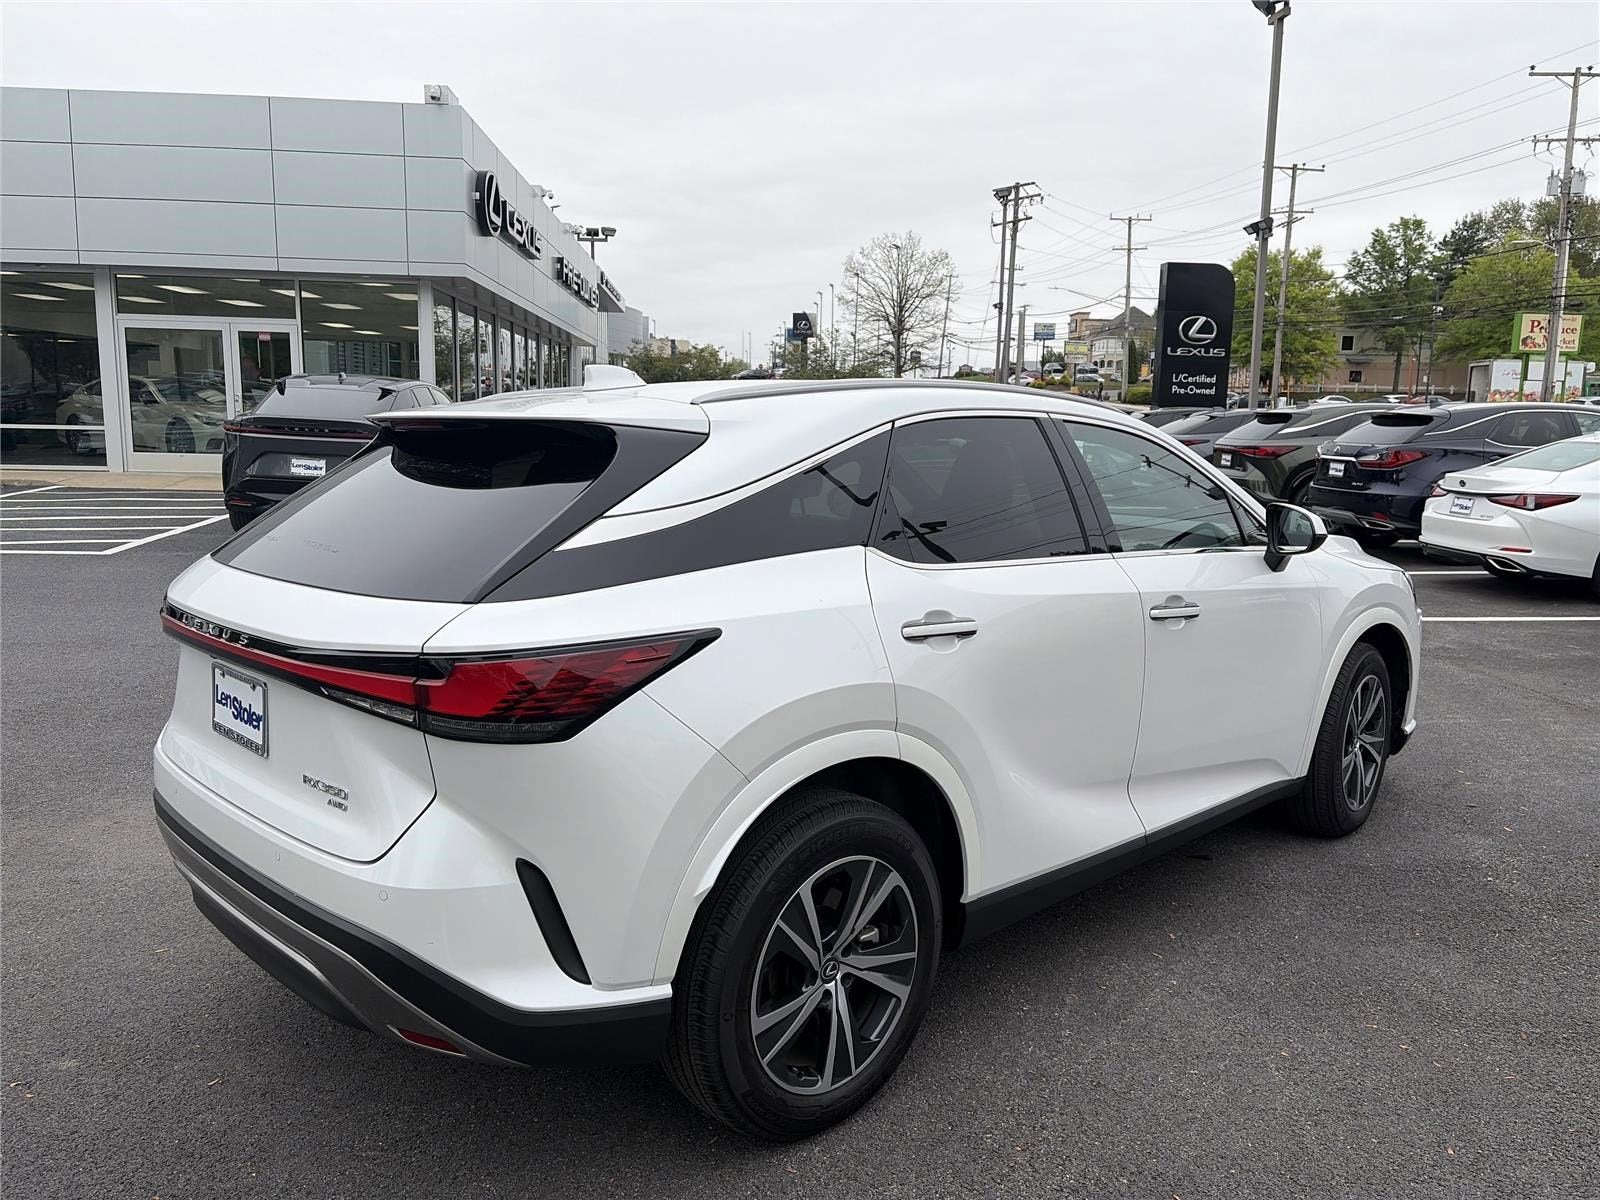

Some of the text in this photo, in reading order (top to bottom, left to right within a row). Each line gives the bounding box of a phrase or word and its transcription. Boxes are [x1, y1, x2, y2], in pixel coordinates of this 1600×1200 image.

[502, 200, 544, 260] LEXUS
[1167, 347, 1226, 357] LEXUS
[1172, 373, 1217, 383] L/Certified
[1171, 385, 1216, 395] Pre-Owned
[181, 613, 250, 646] LEXUS
